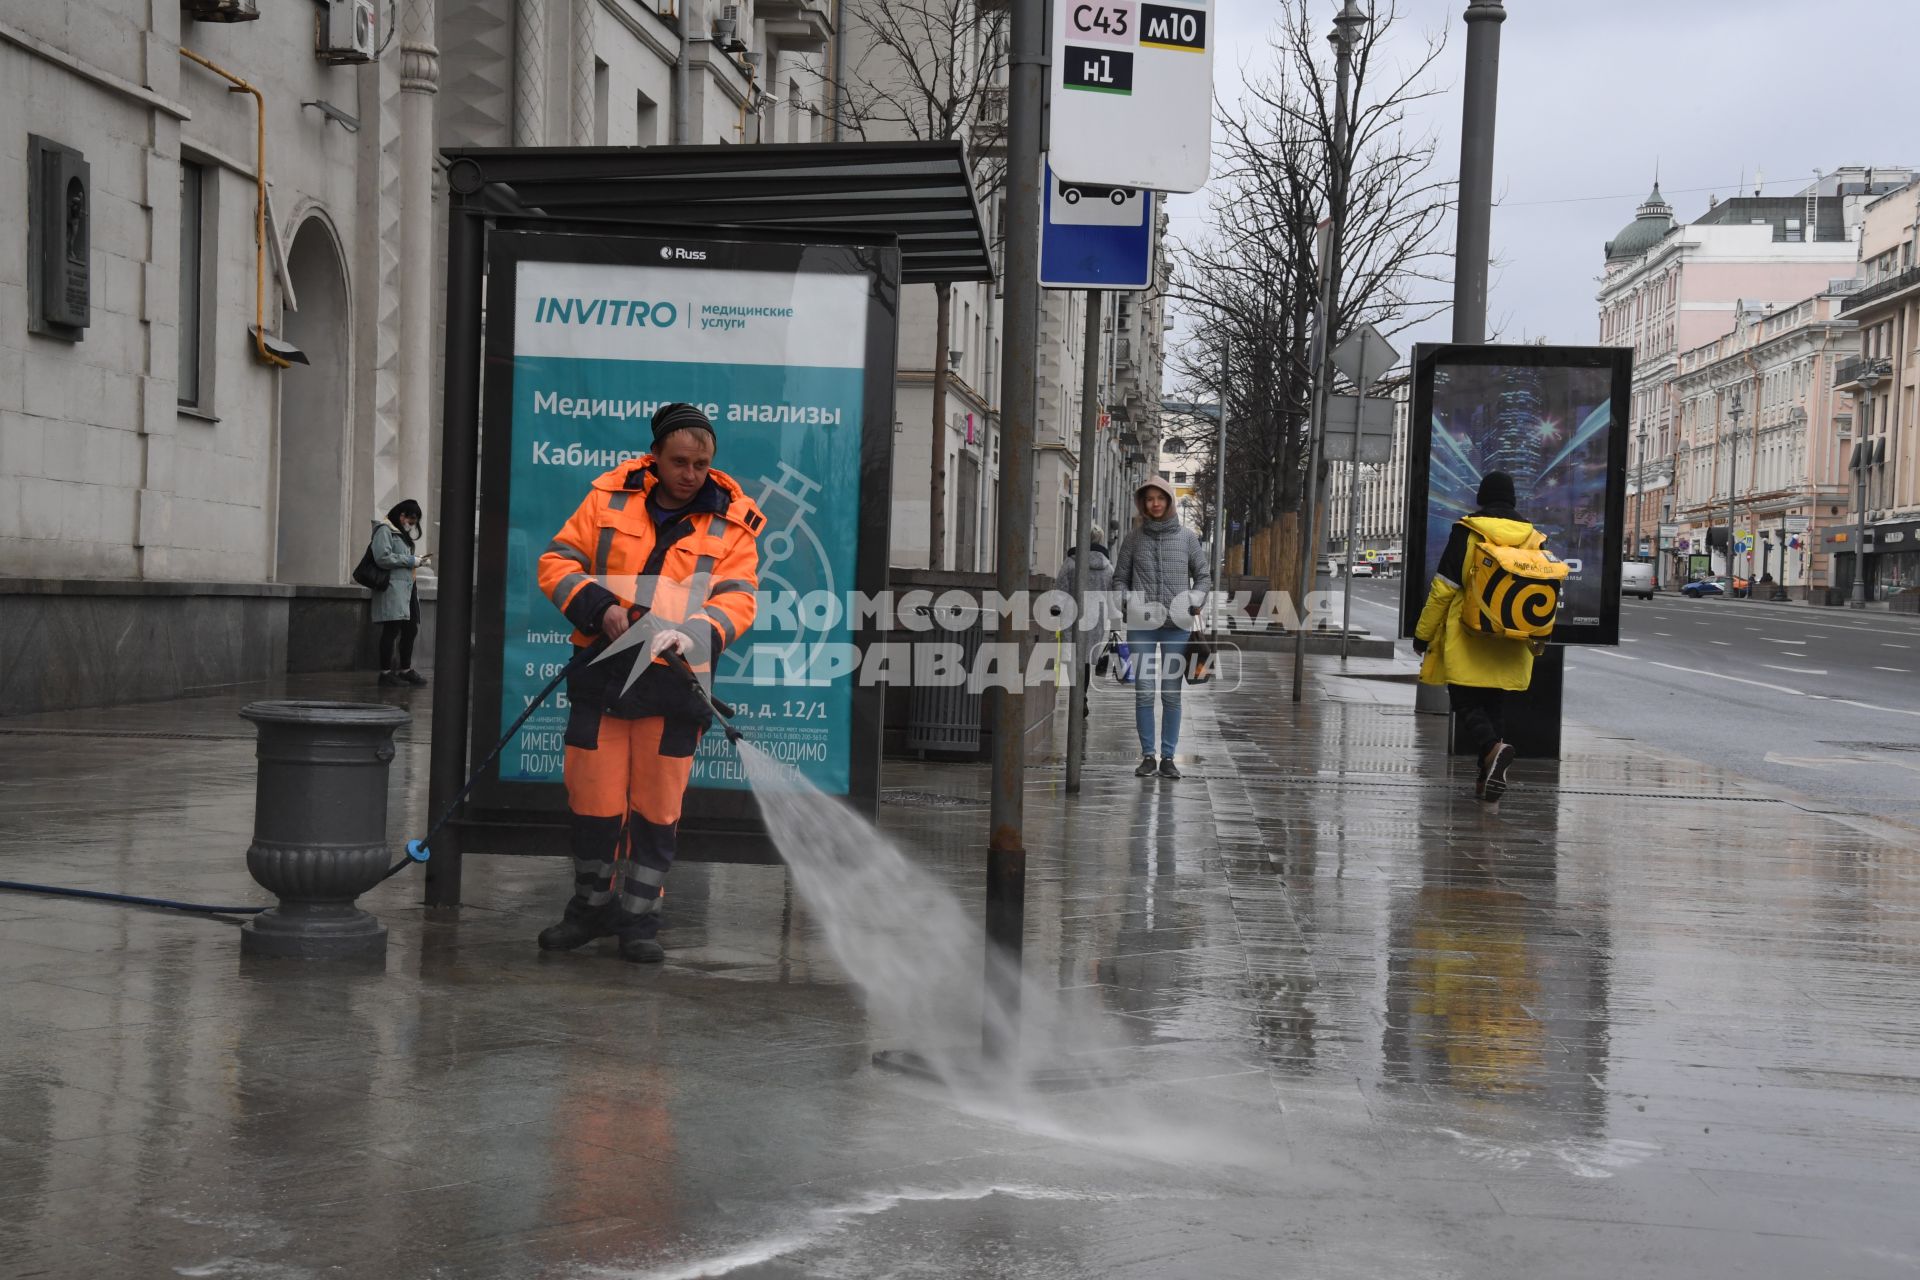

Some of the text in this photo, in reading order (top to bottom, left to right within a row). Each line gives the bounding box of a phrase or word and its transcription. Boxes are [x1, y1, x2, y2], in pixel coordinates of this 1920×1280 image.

[675, 247, 707, 260] Russ
[535, 297, 677, 328] INVITRO
[701, 304, 794, 317] медицинские
[701, 318, 746, 331] услуги
[534, 391, 841, 425] Медицине анализы
[525, 662, 535, 677] 8
[758, 703, 776, 719] д.
[783, 701, 827, 721] 12/1
[735, 740, 827, 762] ОБХОДИМО
